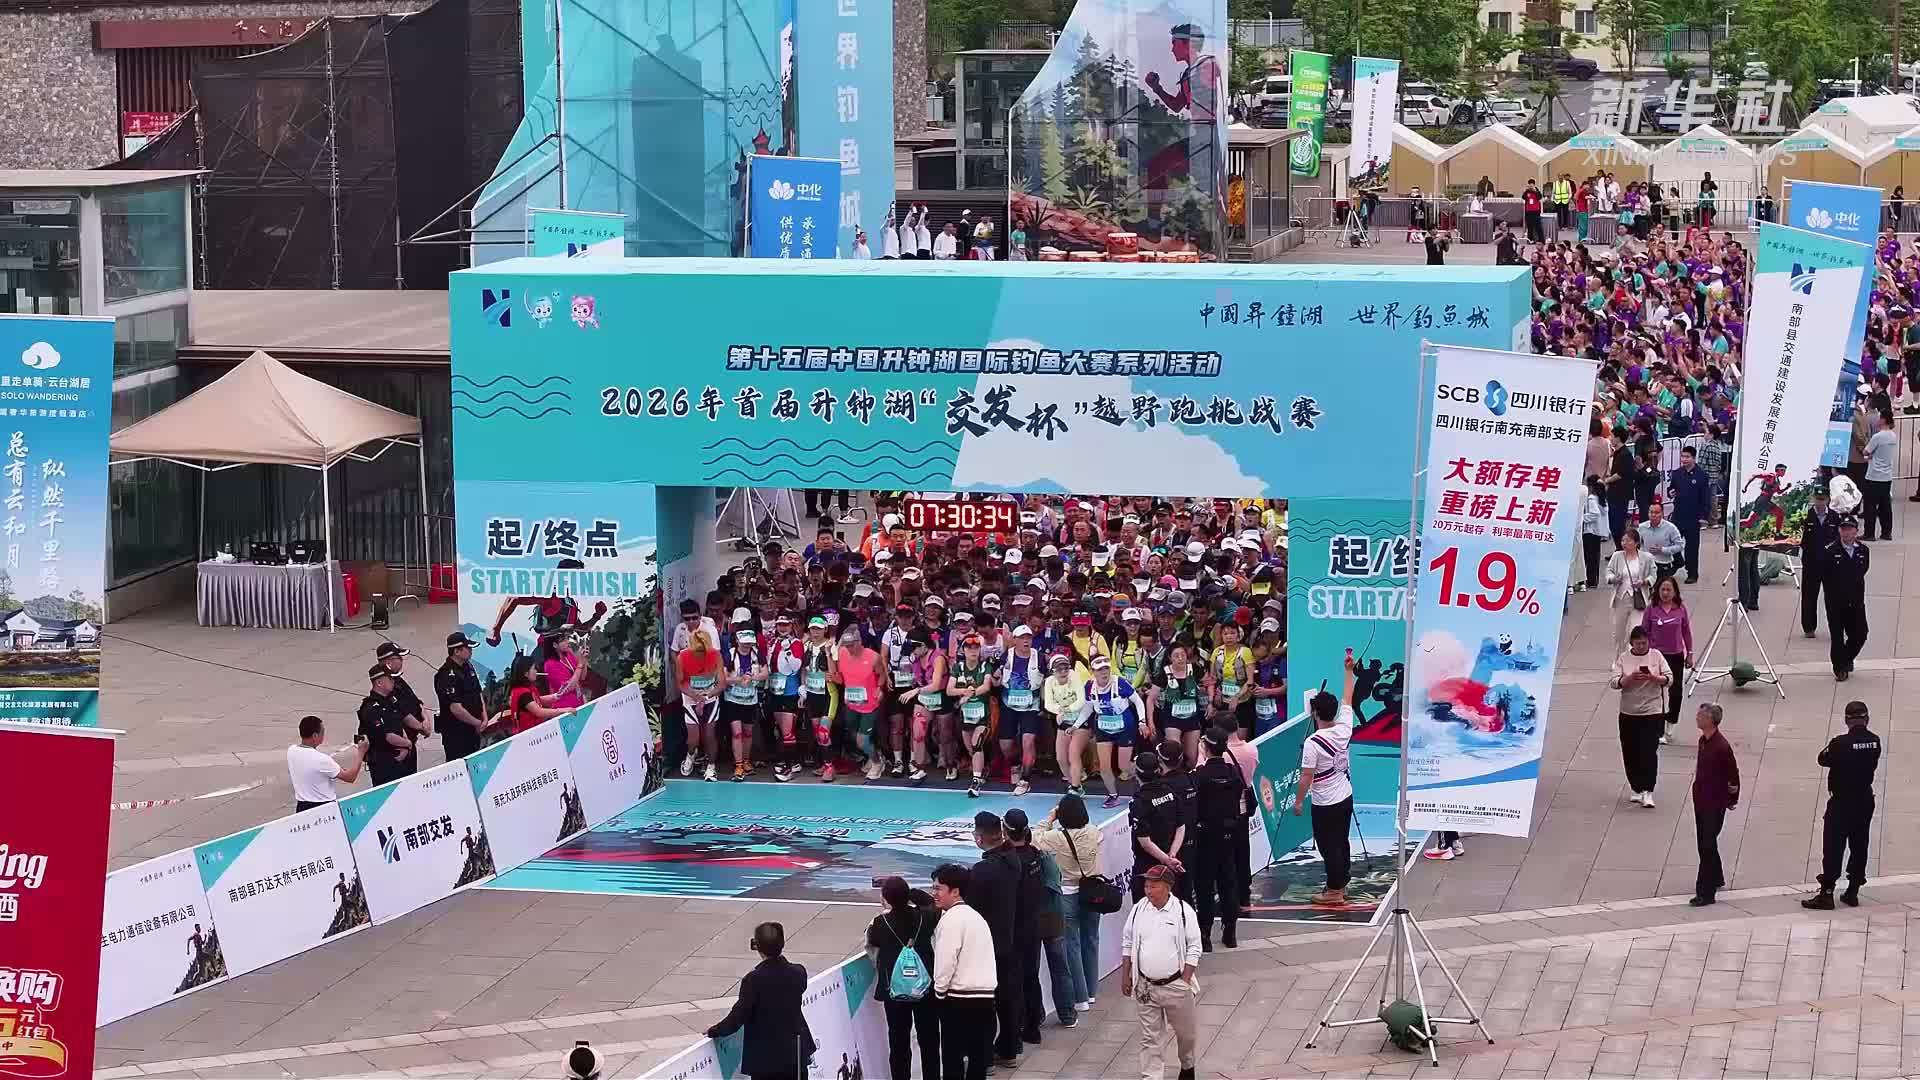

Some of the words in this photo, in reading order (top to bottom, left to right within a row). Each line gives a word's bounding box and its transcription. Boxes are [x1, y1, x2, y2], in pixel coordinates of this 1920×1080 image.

[796, 183, 822, 196] 中化
[1835, 211, 1861, 226] 中化
[726, 345, 1222, 377] 第十五届中国升钟湖国际钓鱼大赛系列活动
[0, 391, 25, 400] SOLO
[26, 392, 79, 401] WANDERING
[1437, 384, 1480, 404] SCB
[1757, 303, 1804, 471] 南部县交通建设发展有限公司
[1510, 391, 1587, 416] 四川银行
[1435, 414, 1582, 443] 四川银行南充南部支行
[1443, 457, 1562, 492] 大额存单
[3, 430, 29, 569] 总有云和月
[1438, 490, 1558, 526] 重磅上新
[910, 503, 1012, 529] 07:30:34
[485, 517, 620, 560] 起/终点
[1432, 519, 1485, 536] 20万元起存
[1491, 524, 1556, 543] 利率最高可达
[470, 567, 640, 598] START/FINISH
[403, 815, 454, 851] 南部交发
[228, 856, 334, 903] 南部县万达天然气有限公司
[20, 1009, 35, 1023] 元
[17, 1025, 49, 1040] 红包
